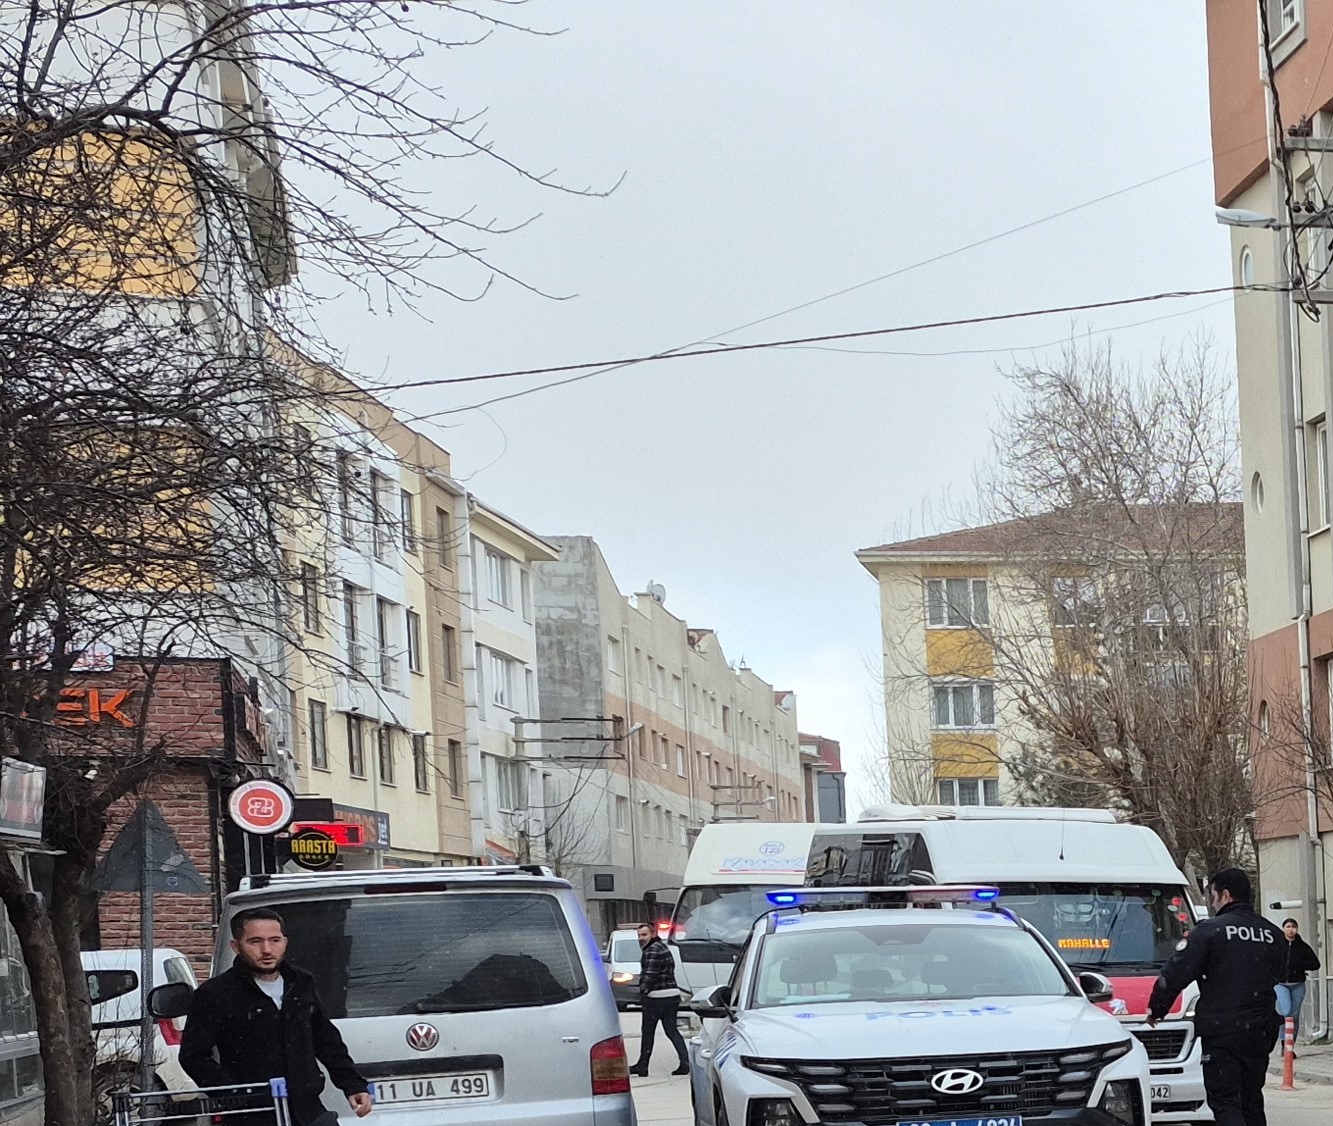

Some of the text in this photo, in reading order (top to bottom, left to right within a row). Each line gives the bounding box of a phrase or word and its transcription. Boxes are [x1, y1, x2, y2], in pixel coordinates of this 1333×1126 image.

[291, 839, 336, 854] ARASTA
[1058, 938, 1110, 949] MAHALLE
[377, 1077, 485, 1100] 11 UA 499
